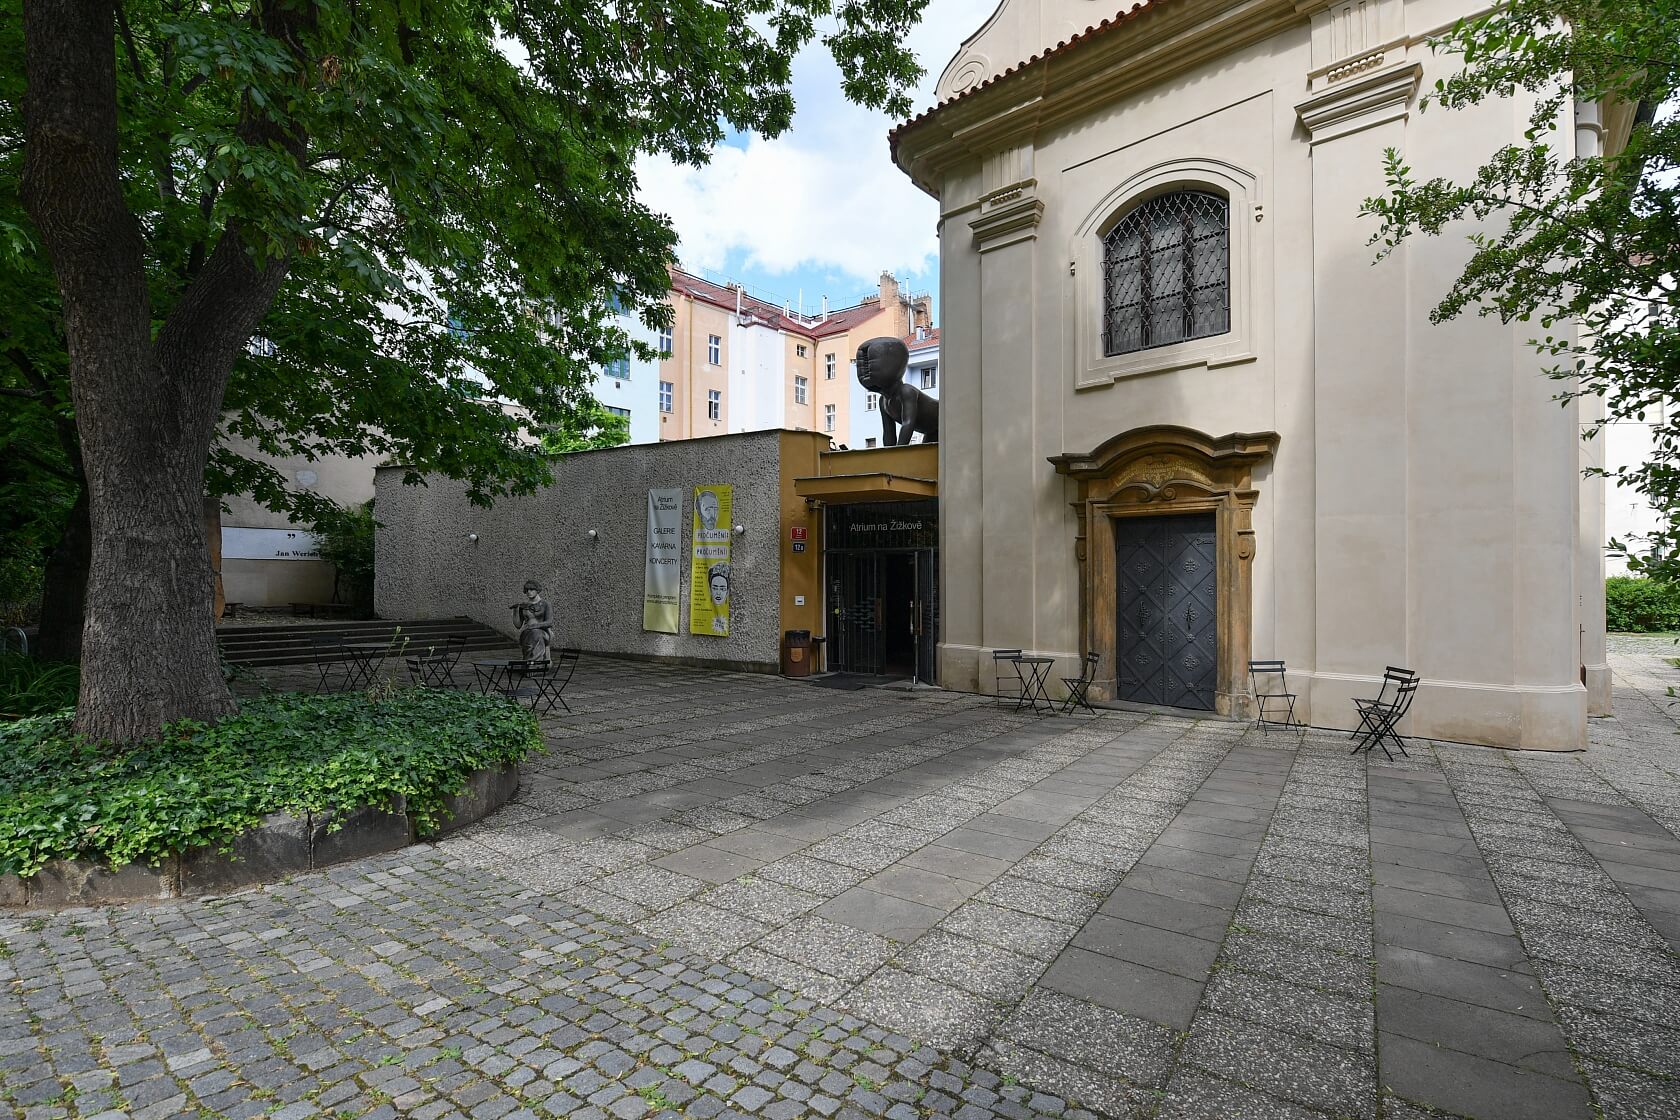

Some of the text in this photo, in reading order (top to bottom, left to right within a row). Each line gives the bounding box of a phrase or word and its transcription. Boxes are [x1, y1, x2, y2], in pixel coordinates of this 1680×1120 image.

[850, 519, 922, 532] Atrium na Žižkově
[653, 527, 676, 535] GALERIE
